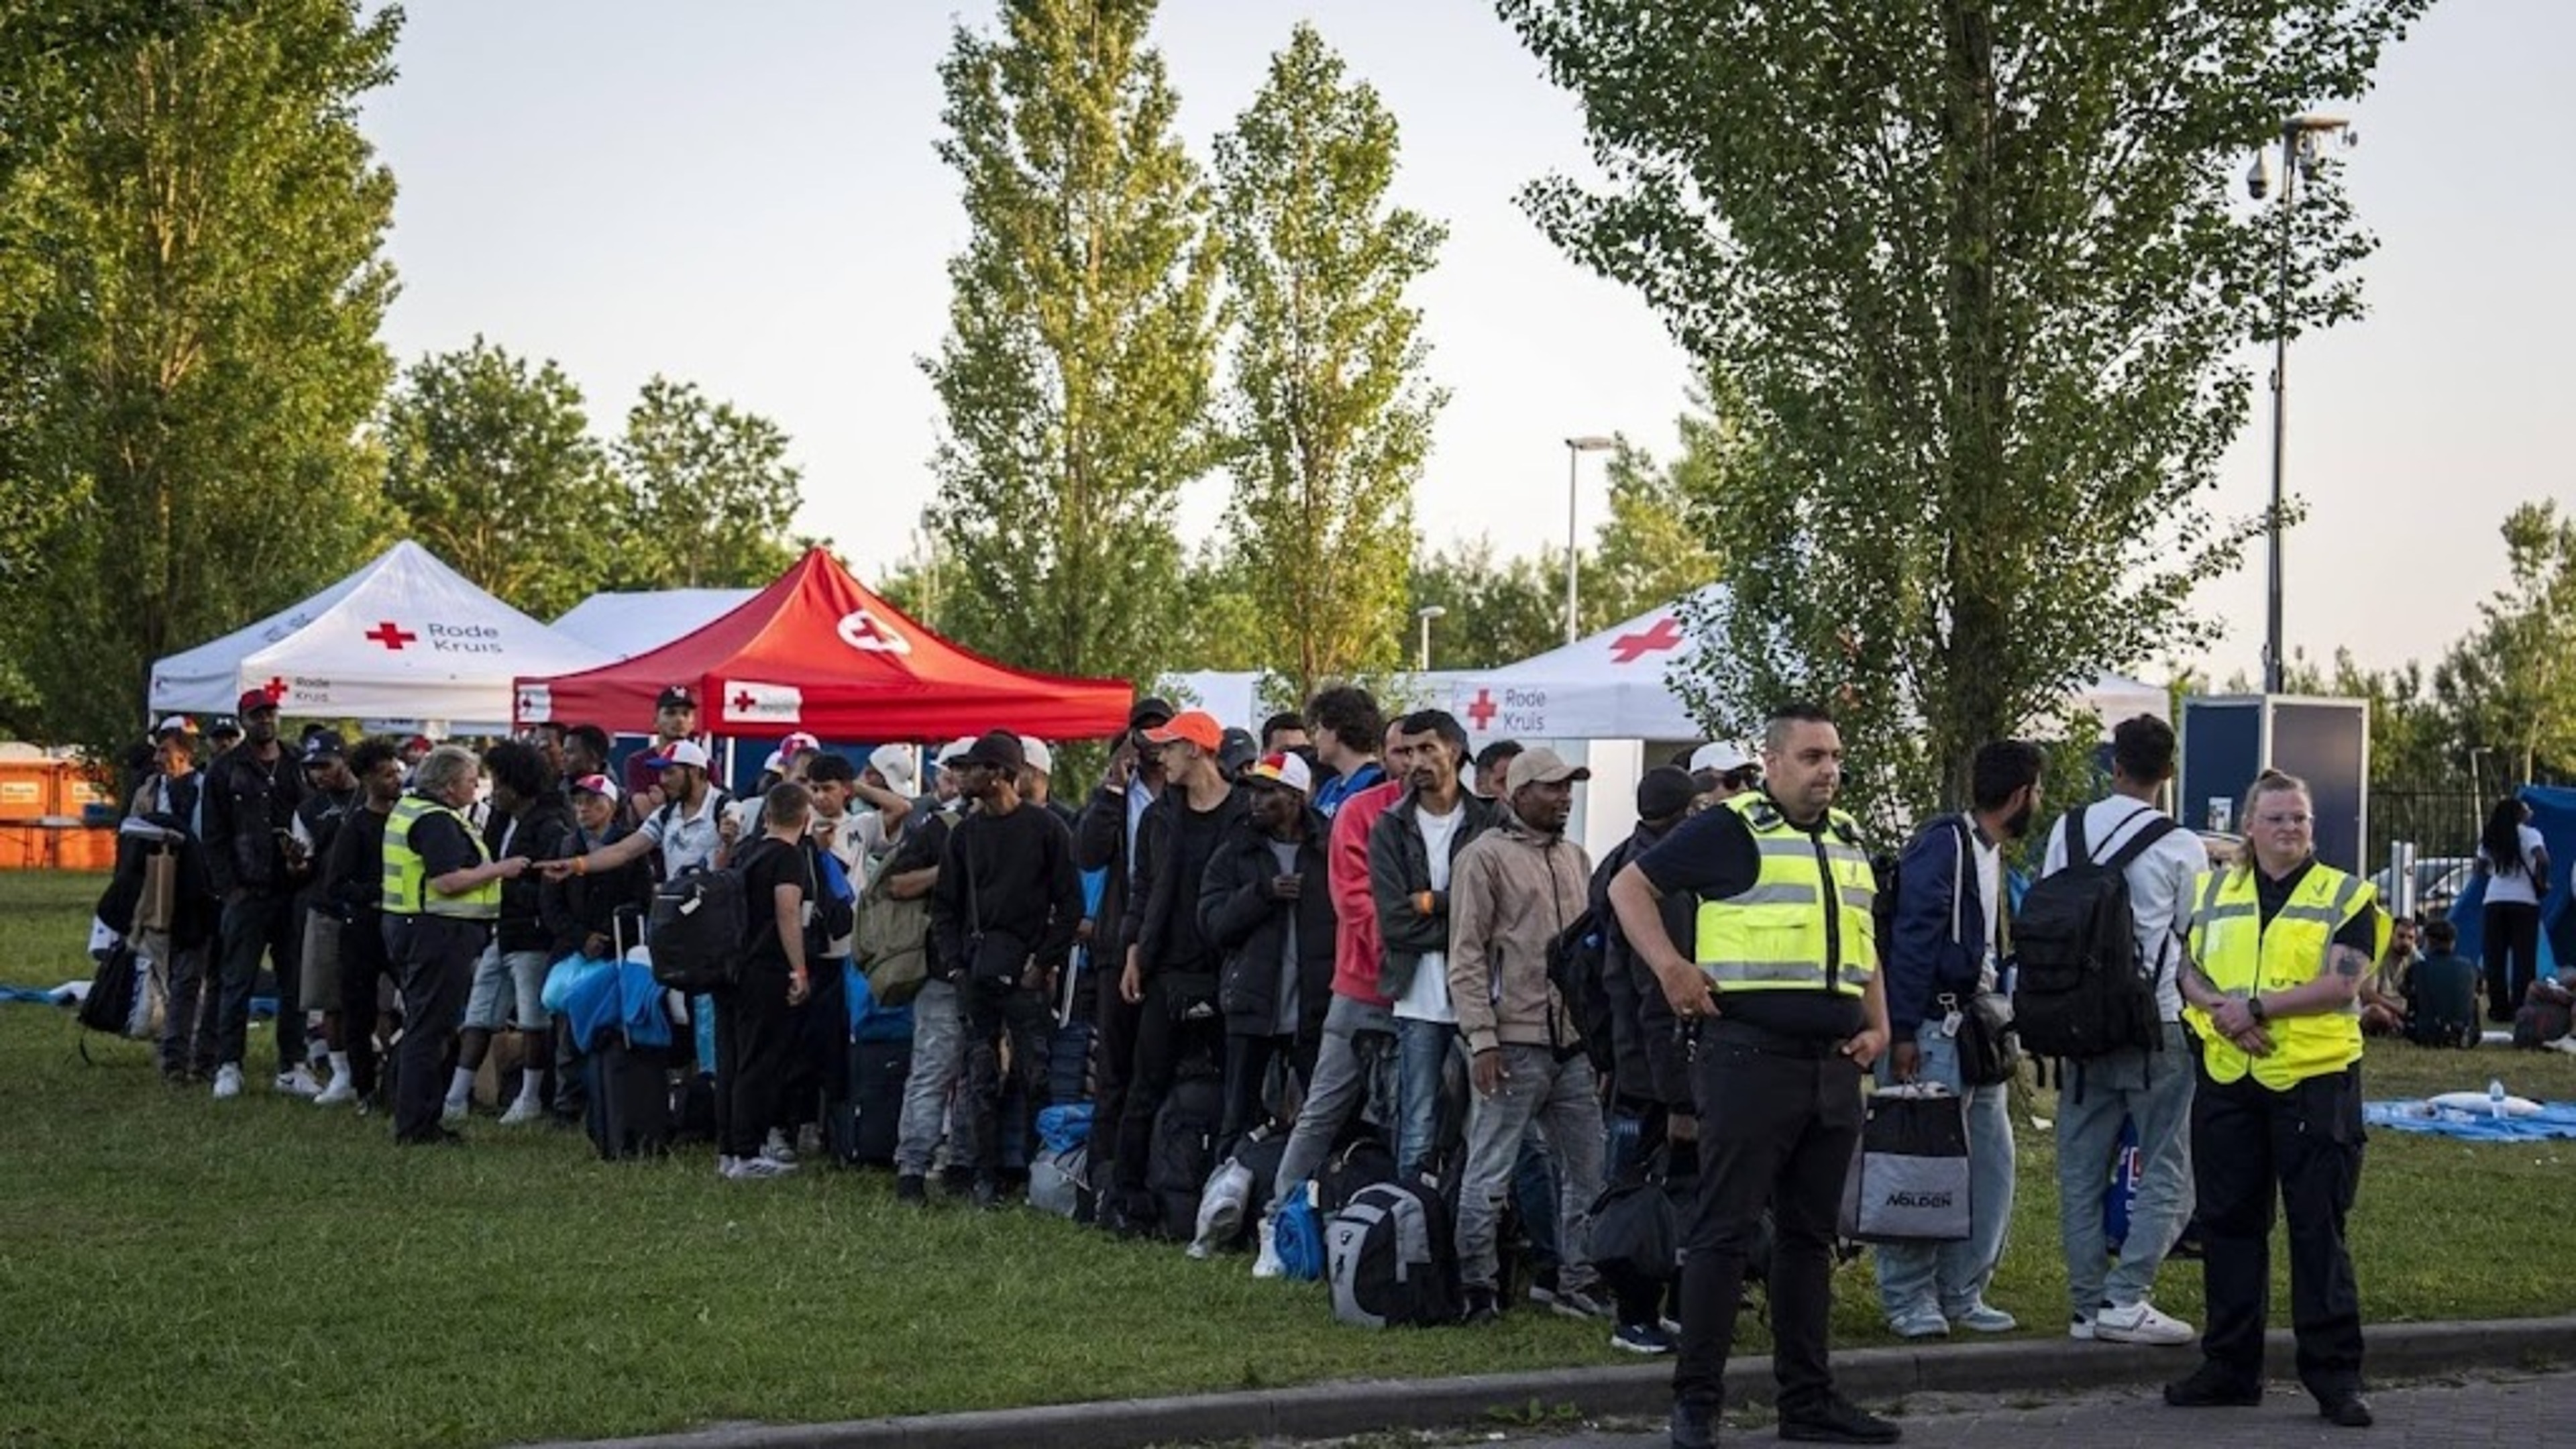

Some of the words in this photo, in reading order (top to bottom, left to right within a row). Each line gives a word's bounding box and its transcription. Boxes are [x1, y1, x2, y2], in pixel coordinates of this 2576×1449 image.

[428, 623, 499, 638] Rode
[433, 639, 503, 653] Kruis
[296, 676, 330, 688] Rode
[296, 692, 329, 702] Kruis
[1505, 688, 1547, 708] Rode
[1503, 711, 1545, 731] Kruis
